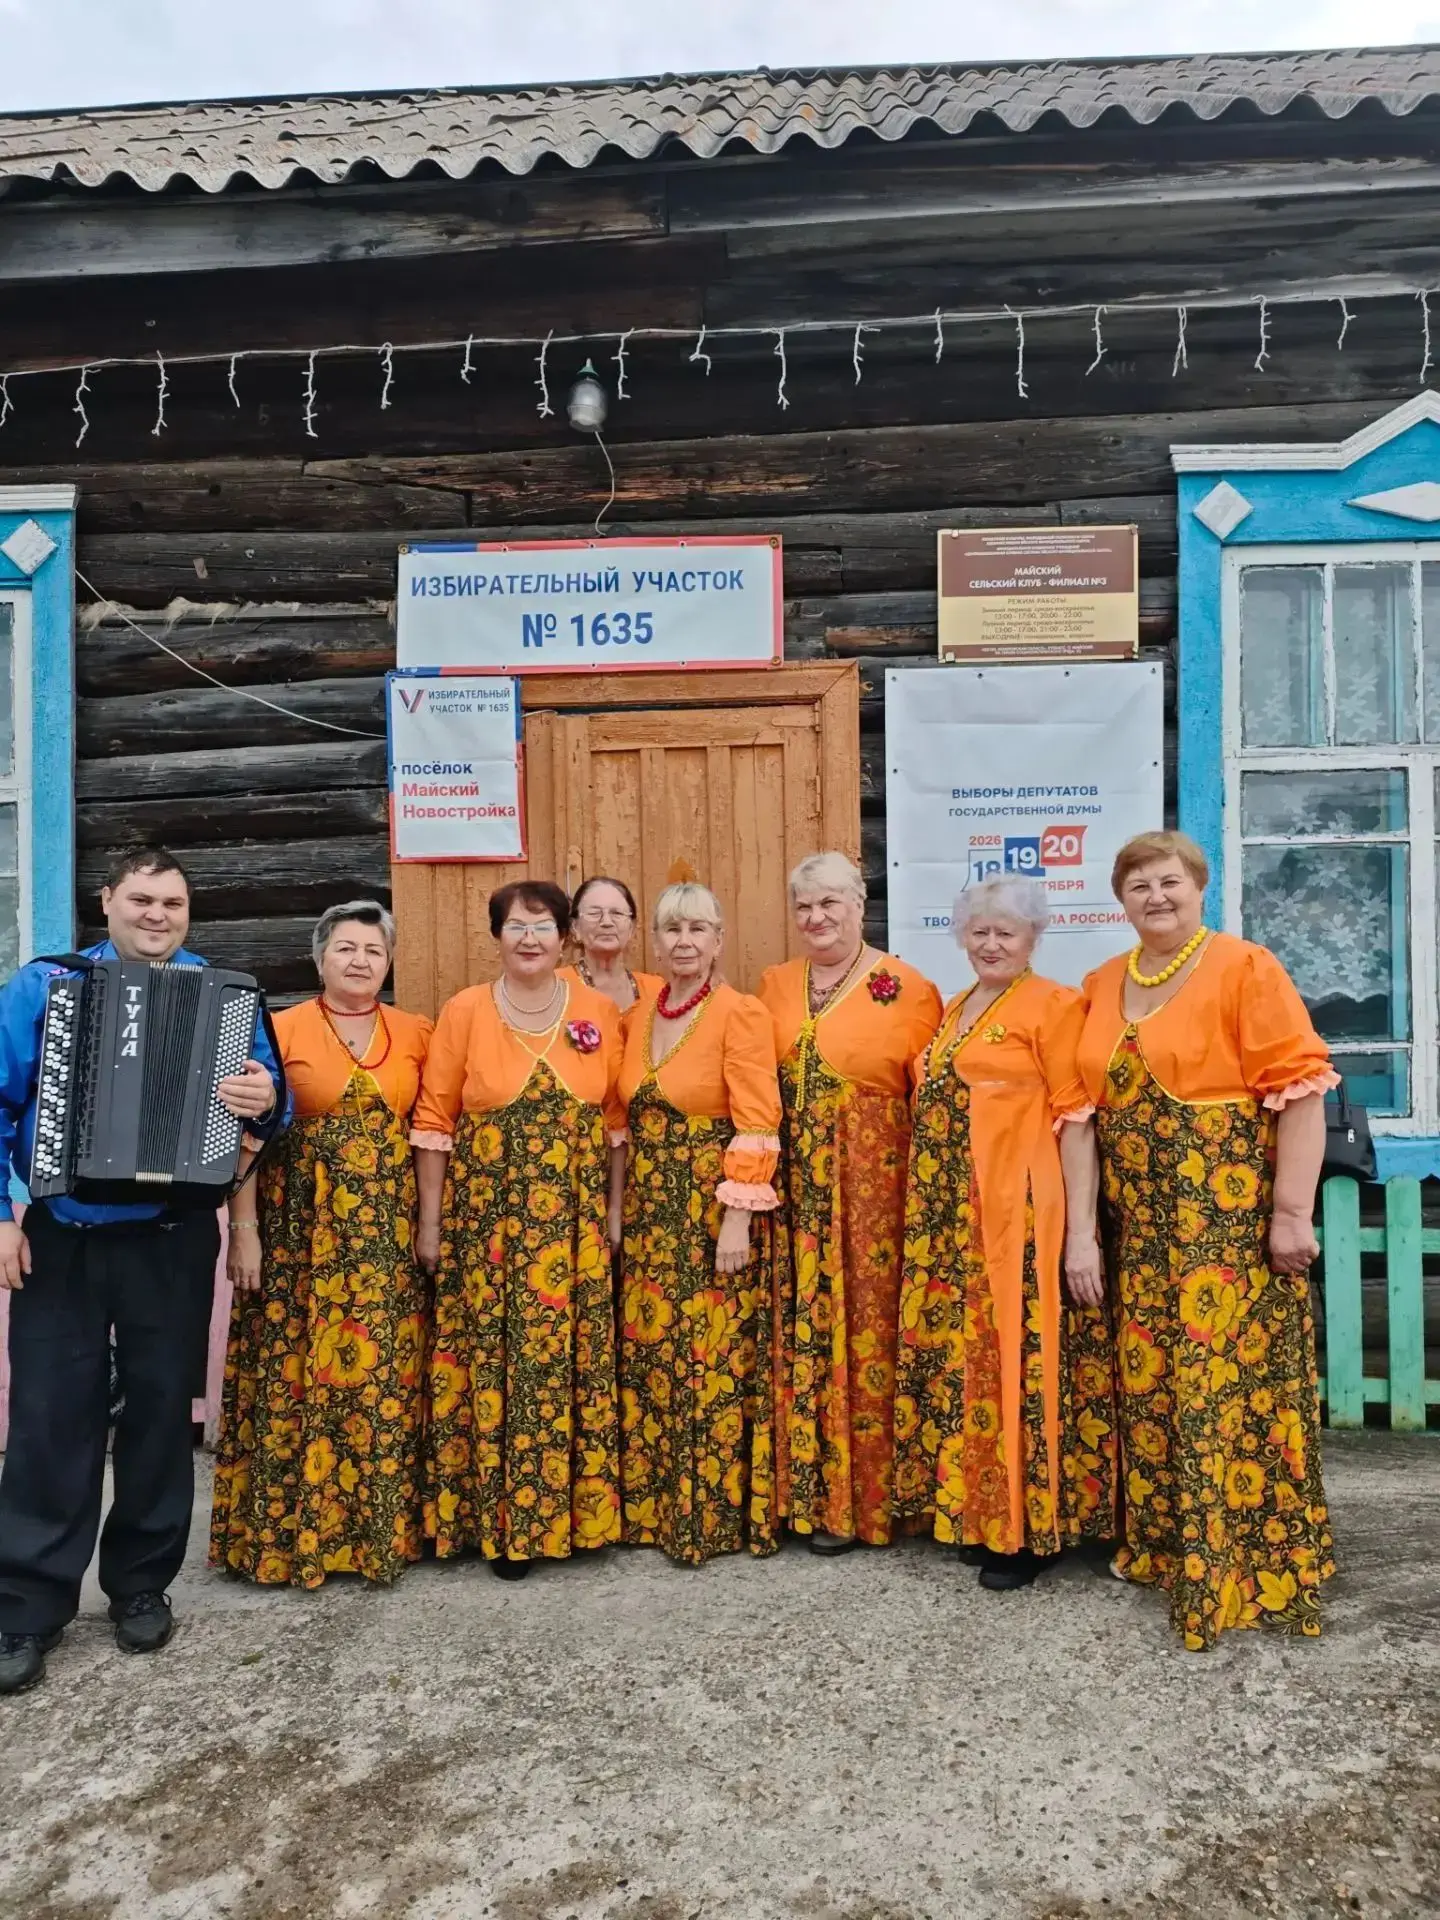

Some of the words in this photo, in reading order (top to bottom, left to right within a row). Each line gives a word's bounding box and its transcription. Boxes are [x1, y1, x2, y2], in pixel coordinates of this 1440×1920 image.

[1014, 565, 1061, 576] МАЙСКИЙ
[410, 566, 620, 598] ИЗБИРАТЕЛЬНЫЙ
[632, 569, 744, 593] УЧАСТОК
[969, 577, 1016, 589] СЕЛЬСКИЙ
[1018, 579, 1042, 588] КЛУБ
[1049, 577, 1089, 587] ФИЛИАЛ
[1007, 597, 1035, 605] РЕЖИМ
[522, 613, 557, 648] №
[570, 612, 653, 647] 1635
[428, 687, 510, 700] ИЗБИРАТЕЛЬНЫЙ
[429, 704, 472, 713] УЧАСТОК
[477, 704, 487, 713] №
[489, 703, 509, 712] 1635
[402, 761, 473, 775] посёлок
[402, 781, 480, 797] Майский
[952, 788, 1013, 799] ВЫБОРЫ
[1017, 786, 1098, 799] ДЕПУТАТОВ
[403, 802, 516, 821] Новостройка
[949, 804, 1063, 817] ГОСУДАРСТВЕННОЙ
[1066, 804, 1102, 816] ДУМЫ
[969, 835, 1001, 846] 2026
[1008, 847, 1038, 870] 19
[1044, 834, 1079, 858] 20
[923, 916, 955, 927] ТВО
[121, 986, 142, 1056] ТУЛА
